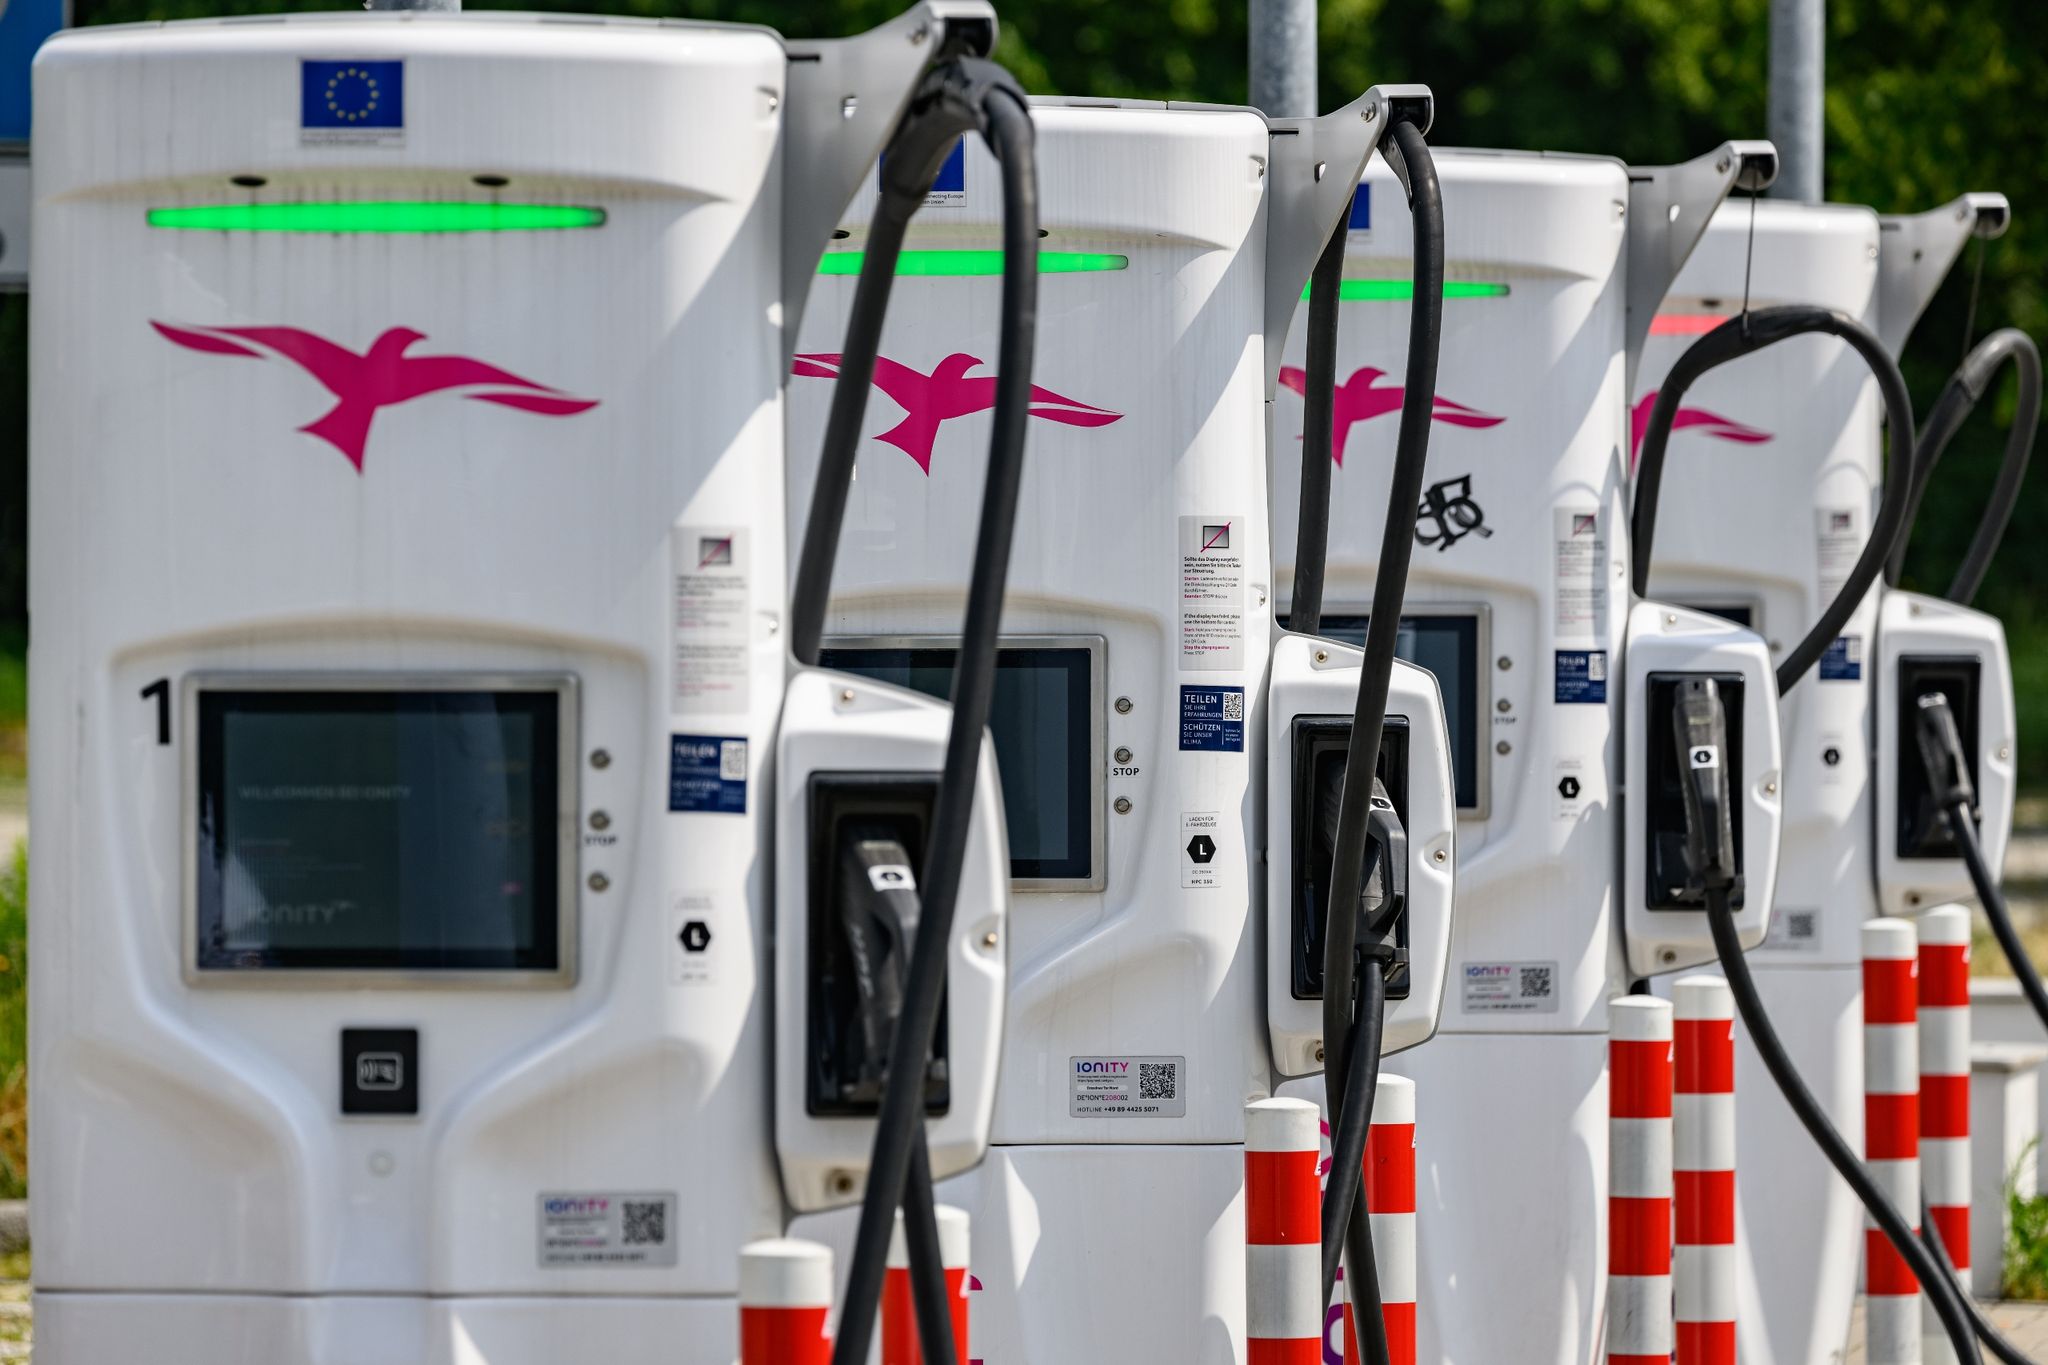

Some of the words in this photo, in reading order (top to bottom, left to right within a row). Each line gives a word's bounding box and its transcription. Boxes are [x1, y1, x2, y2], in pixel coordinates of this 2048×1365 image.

[1184, 694, 1217, 703] TEILEN
[140, 678, 170, 744] 1
[1184, 722, 1220, 730] SCHÜTZEN
[1113, 768, 1140, 776] STOP
[1200, 844, 1207, 855] L
[1077, 1062, 1128, 1073] IONITY
